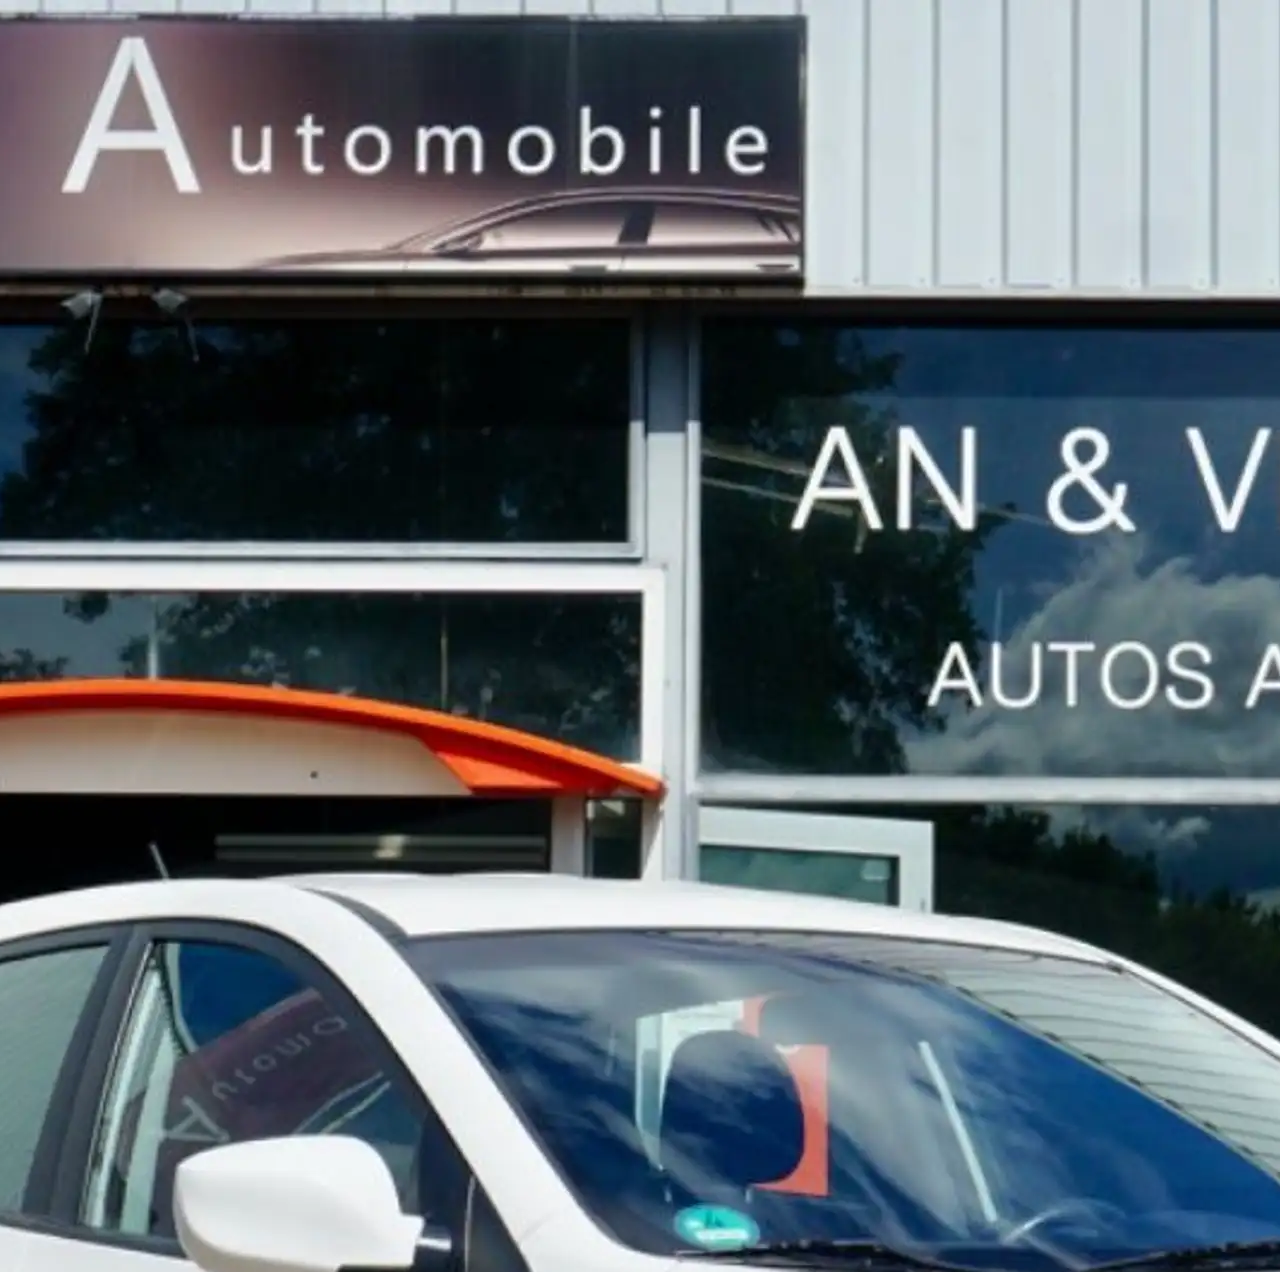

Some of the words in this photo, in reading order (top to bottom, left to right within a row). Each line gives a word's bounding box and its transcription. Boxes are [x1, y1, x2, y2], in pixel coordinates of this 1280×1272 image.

[61, 36, 769, 193] Automobile
[791, 426, 978, 531] AN
[1046, 428, 1136, 533] &
[927, 641, 1214, 709] AUTOS
